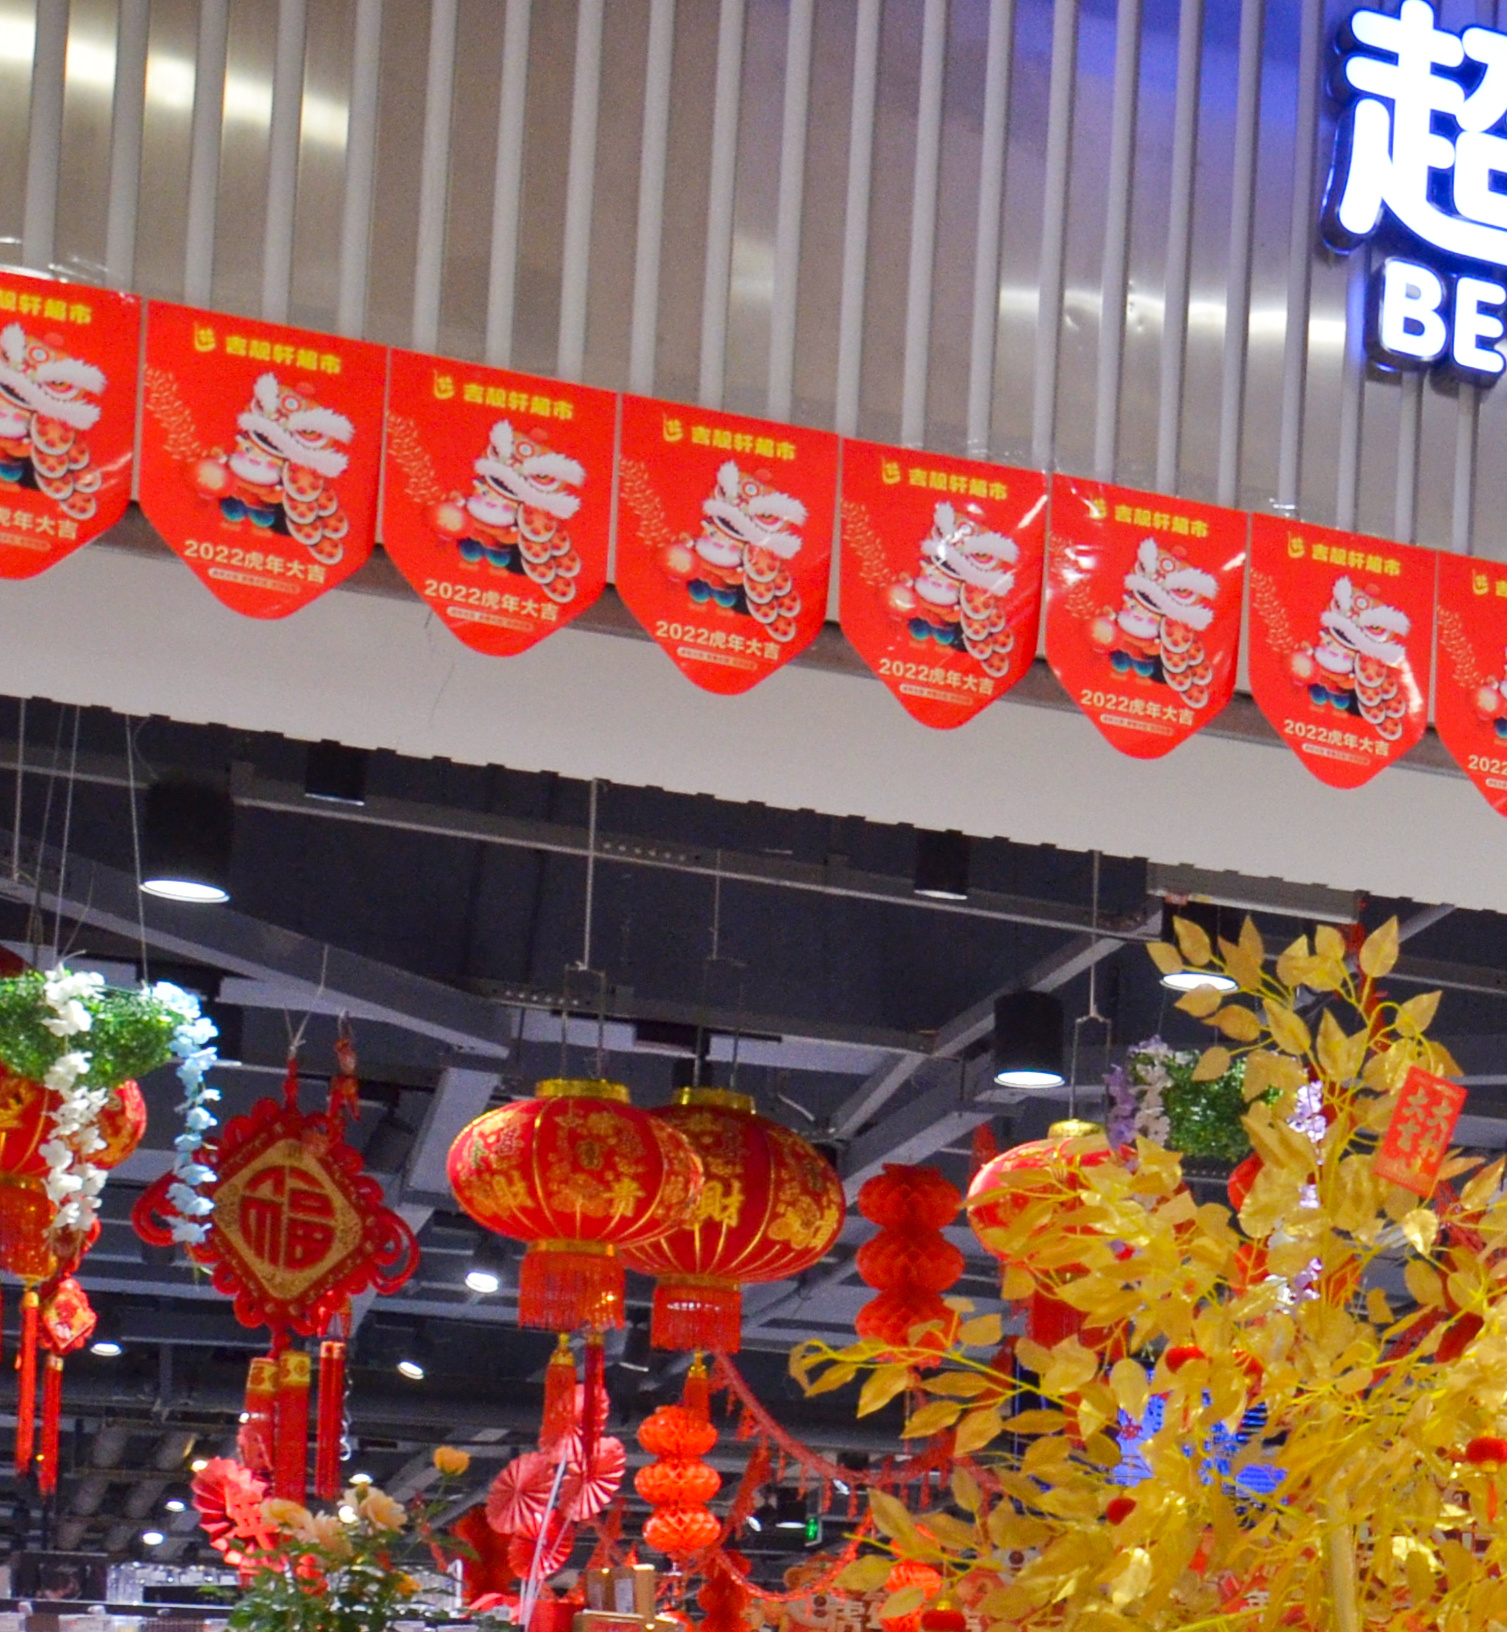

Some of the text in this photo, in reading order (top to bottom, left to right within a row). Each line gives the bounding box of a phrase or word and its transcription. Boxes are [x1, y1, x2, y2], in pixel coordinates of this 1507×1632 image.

[184, 539, 326, 584] 2022虎年大吉
[425, 580, 559, 623] 2022虎年大吉
[655, 620, 781, 661] 2022虎年大吉
[879, 658, 993, 695] 2022虎年大吉
[238, 1164, 337, 1271] 福
